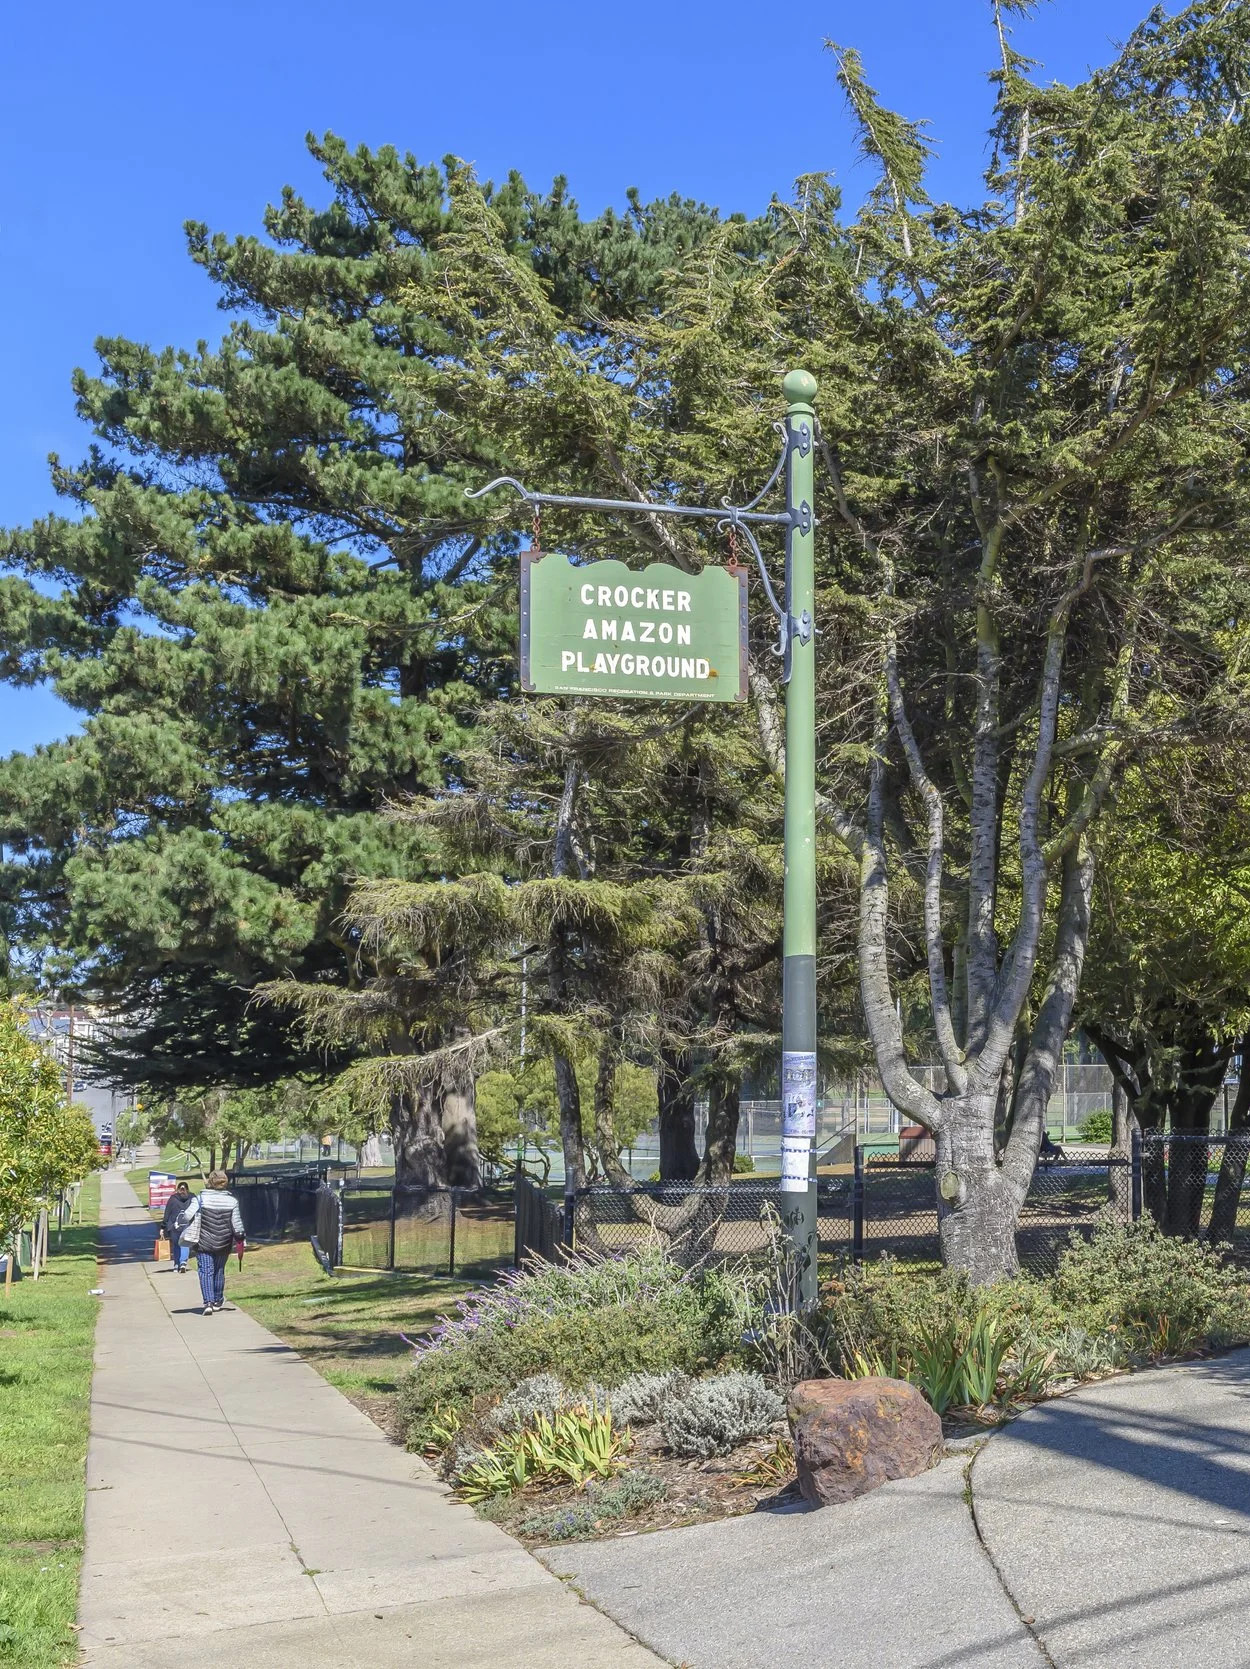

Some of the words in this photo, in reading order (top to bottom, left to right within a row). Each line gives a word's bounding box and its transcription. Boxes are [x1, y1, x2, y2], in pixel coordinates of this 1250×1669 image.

[580, 584, 692, 612] CROCKER
[582, 618, 691, 645] AMAZON
[561, 651, 710, 679] PLAYGROUND
